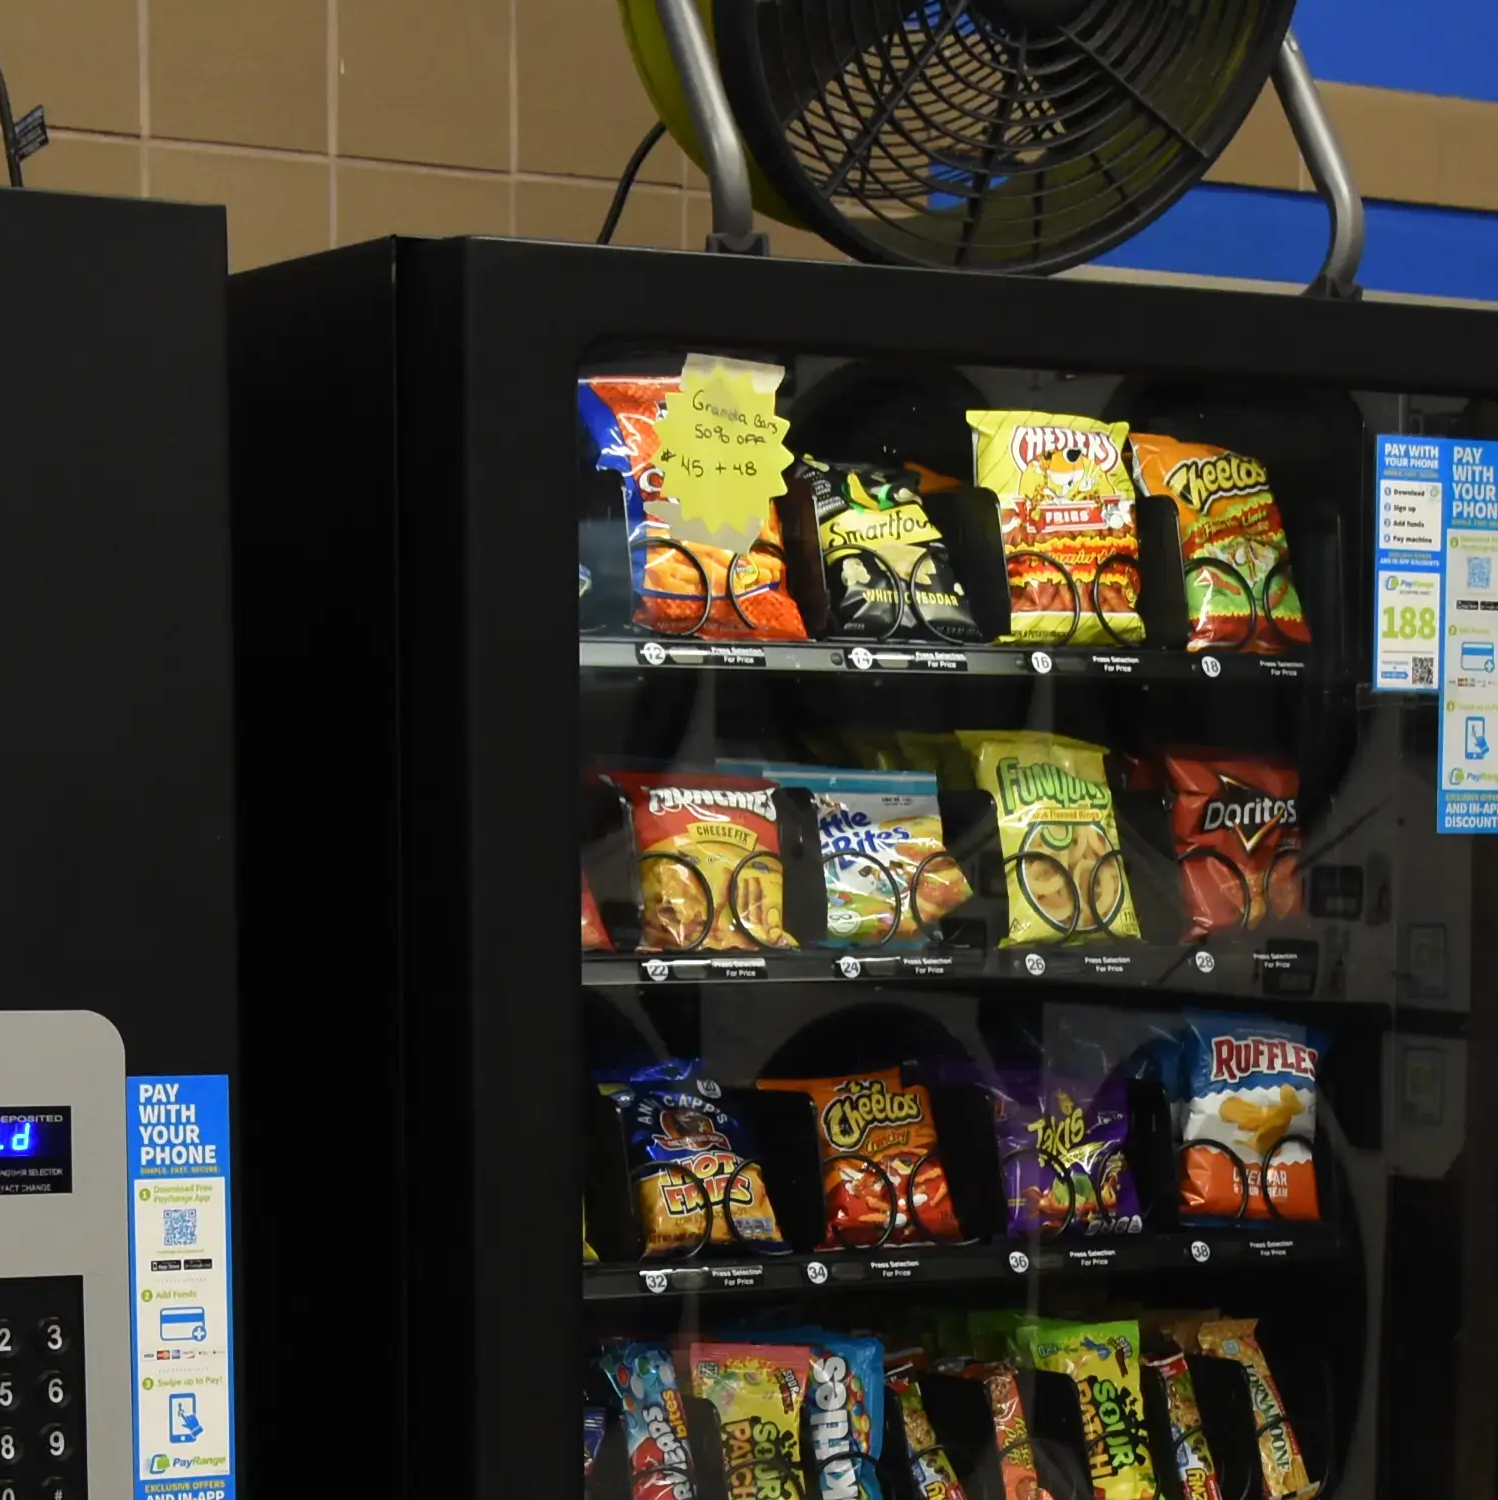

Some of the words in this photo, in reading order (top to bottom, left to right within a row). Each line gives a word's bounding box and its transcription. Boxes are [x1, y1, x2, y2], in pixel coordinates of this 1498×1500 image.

[692, 389, 749, 426] Granola
[694, 424, 730, 444] 50%
[1384, 444, 1407, 456] PAY
[1408, 445, 1439, 458] WITH
[1453, 446, 1483, 465] PAY
[681, 456, 705, 478] 45
[732, 461, 758, 477] 48
[1384, 456, 1408, 467] YOUR
[1410, 458, 1439, 469] PHONE
[1167, 454, 1267, 511] Cheetos
[1452, 465, 1494, 483] WITH
[1452, 482, 1496, 501] YOUR
[1045, 511, 1090, 524] FRIES
[1382, 606, 1436, 640] 188
[1204, 797, 1297, 831] Doritos
[1445, 803, 1467, 815] AND
[696, 825, 733, 840] CHEESE
[734, 829, 751, 844] FIX
[831, 824, 911, 871] Bites
[1211, 1036, 1318, 1083] RUFFLES
[139, 1083, 180, 1104] PAY
[138, 1104, 196, 1124] WITH
[662, 1093, 728, 1124] CAPP'S
[829, 1093, 920, 1147] Cheetos
[138, 1125, 200, 1145] YOUR
[140, 1145, 217, 1166] PHONE
[665, 1152, 737, 1187] HOT
[195, 1184, 213, 1192] Free
[173, 1289, 197, 1299] Funds
[47, 1324, 63, 1350] 3
[48, 1378, 64, 1403] 6
[661, 1388, 689, 1439] bites
[1093, 1378, 1135, 1469] SOUR
[0, 1434, 15, 1460] 8
[49, 1430, 65, 1456] 9
[172, 1455, 227, 1468] PayRange
[753, 1420, 785, 1500] SOUR
[144, 1482, 191, 1493] EXCLUSIVE
